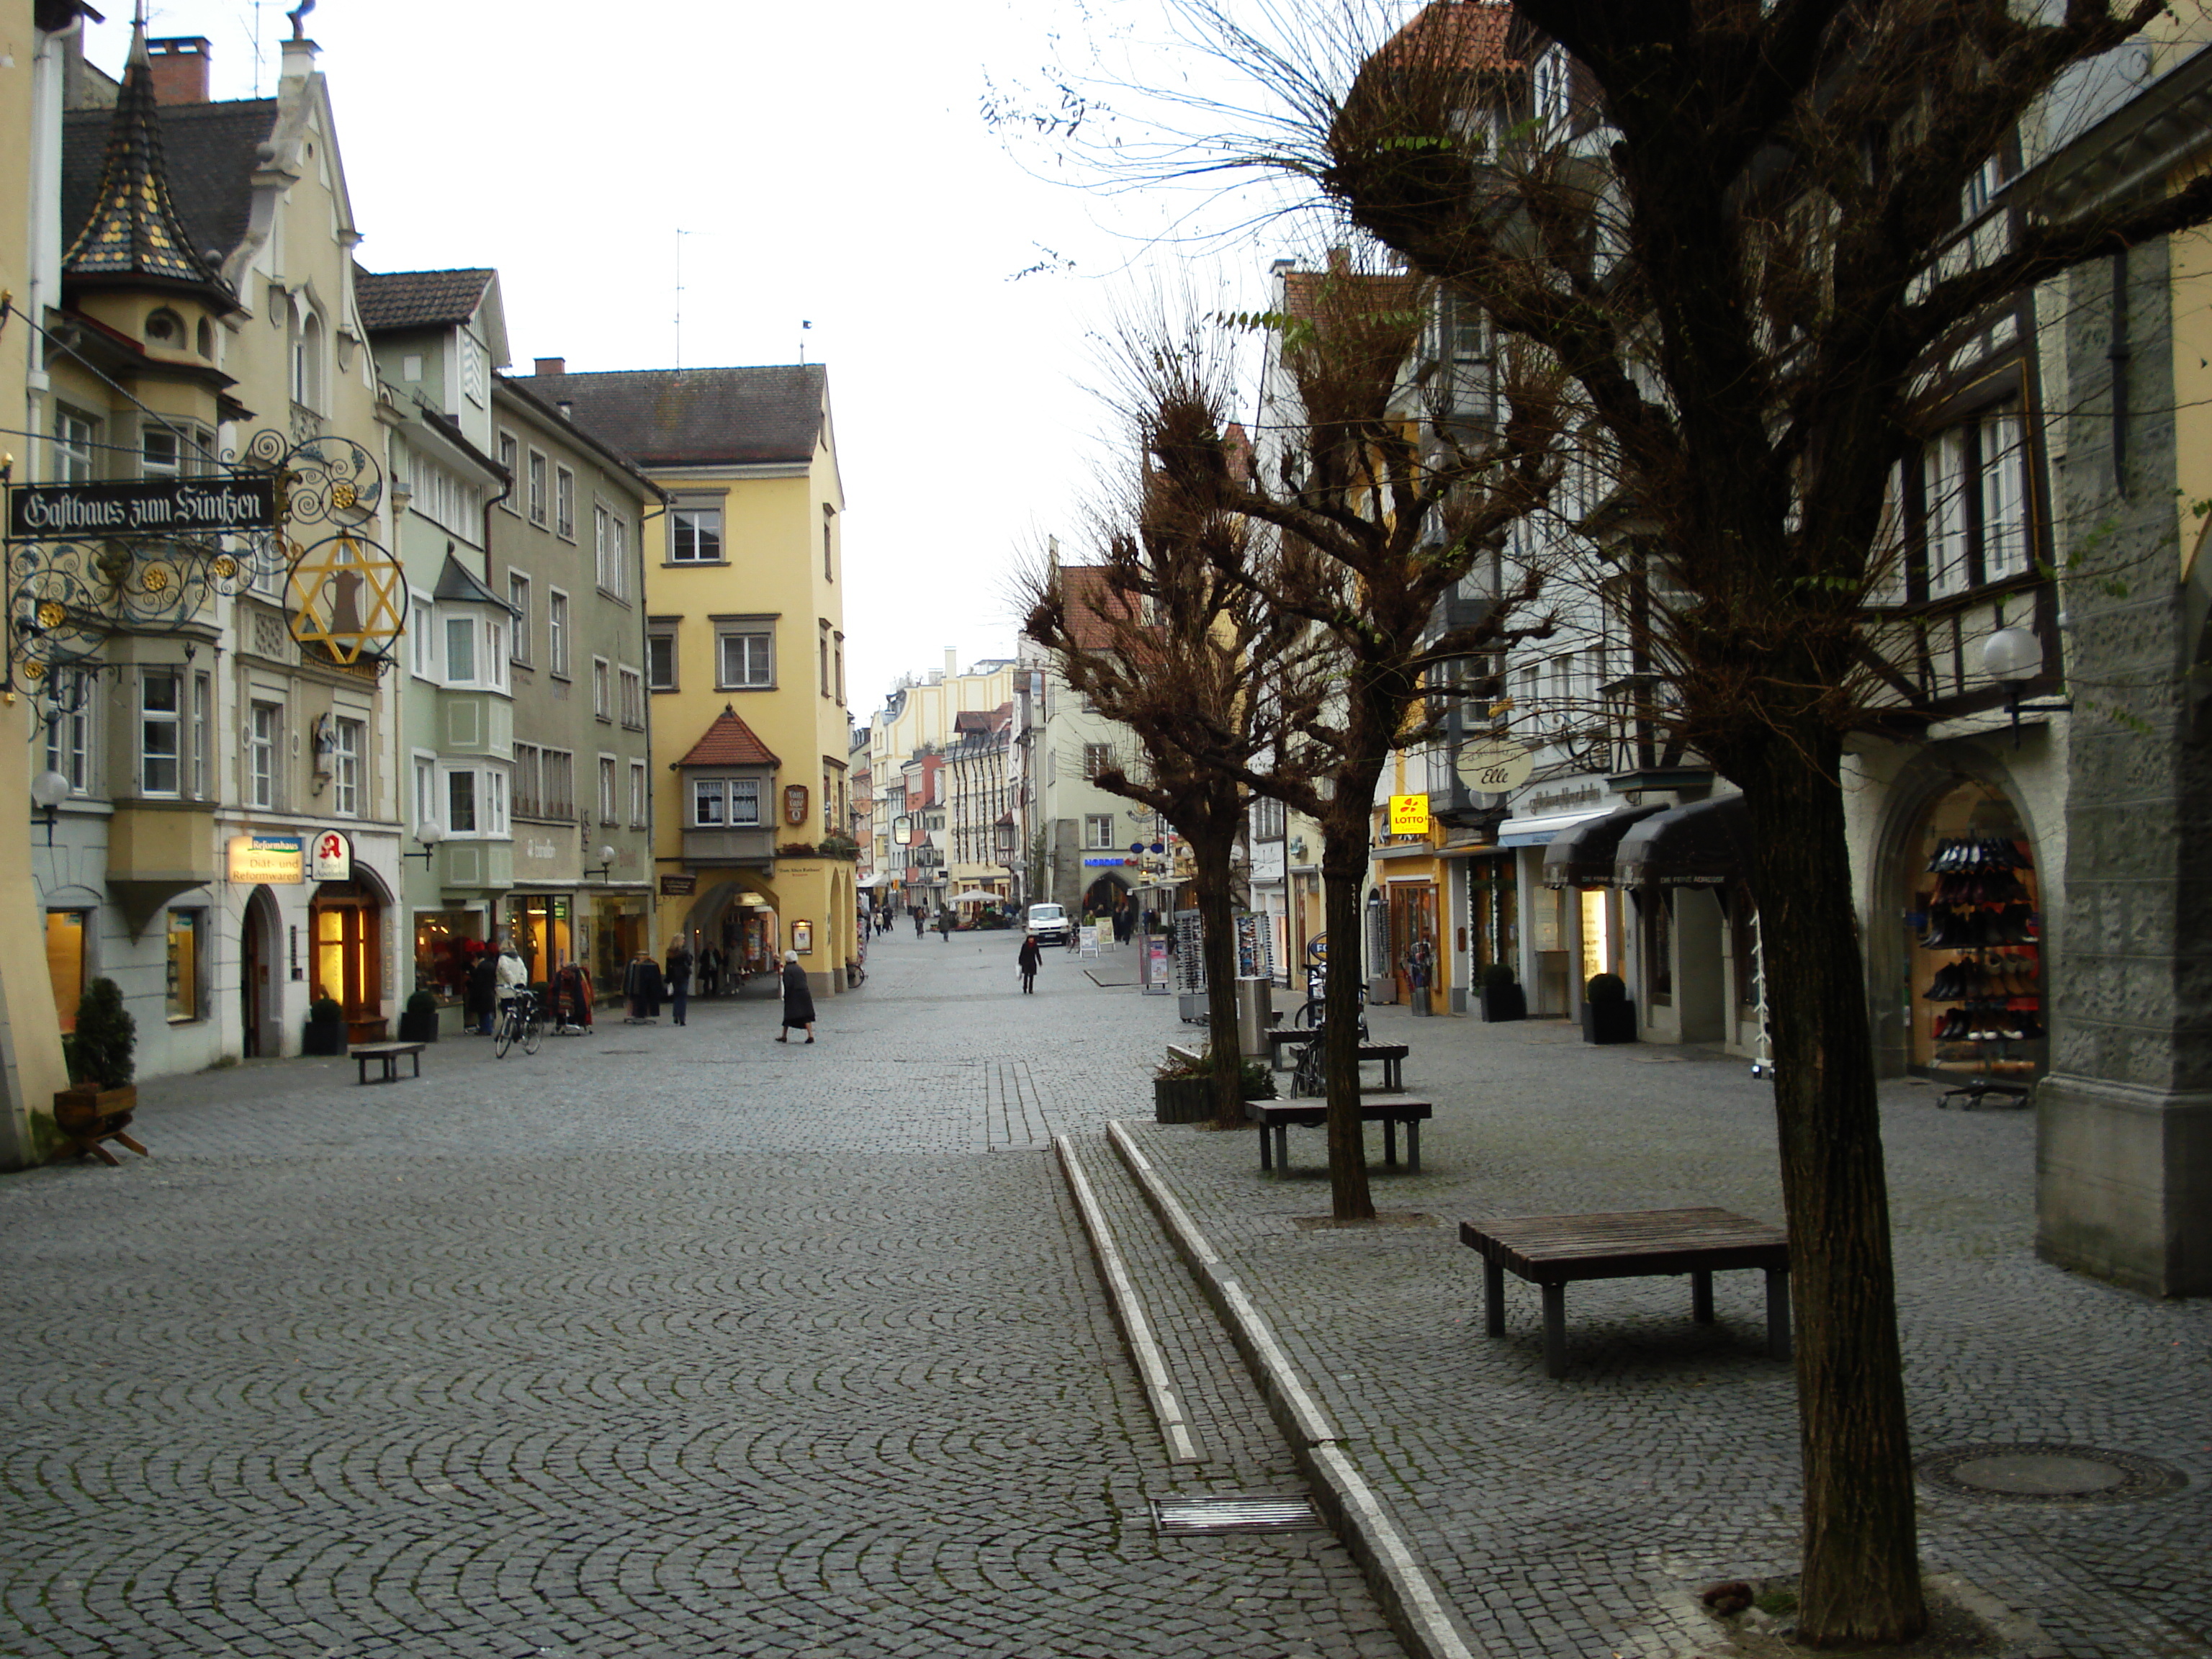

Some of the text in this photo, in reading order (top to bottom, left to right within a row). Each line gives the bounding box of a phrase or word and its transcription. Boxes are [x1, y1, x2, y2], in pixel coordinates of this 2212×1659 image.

[24, 493, 125, 532] Gasthaus
[130, 498, 172, 529] zum
[1481, 768, 1509, 785] Elle
[253, 840, 299, 850] Reformhaus
[250, 859, 299, 868] Diät- und
[233, 871, 299, 881] Reformwaren
